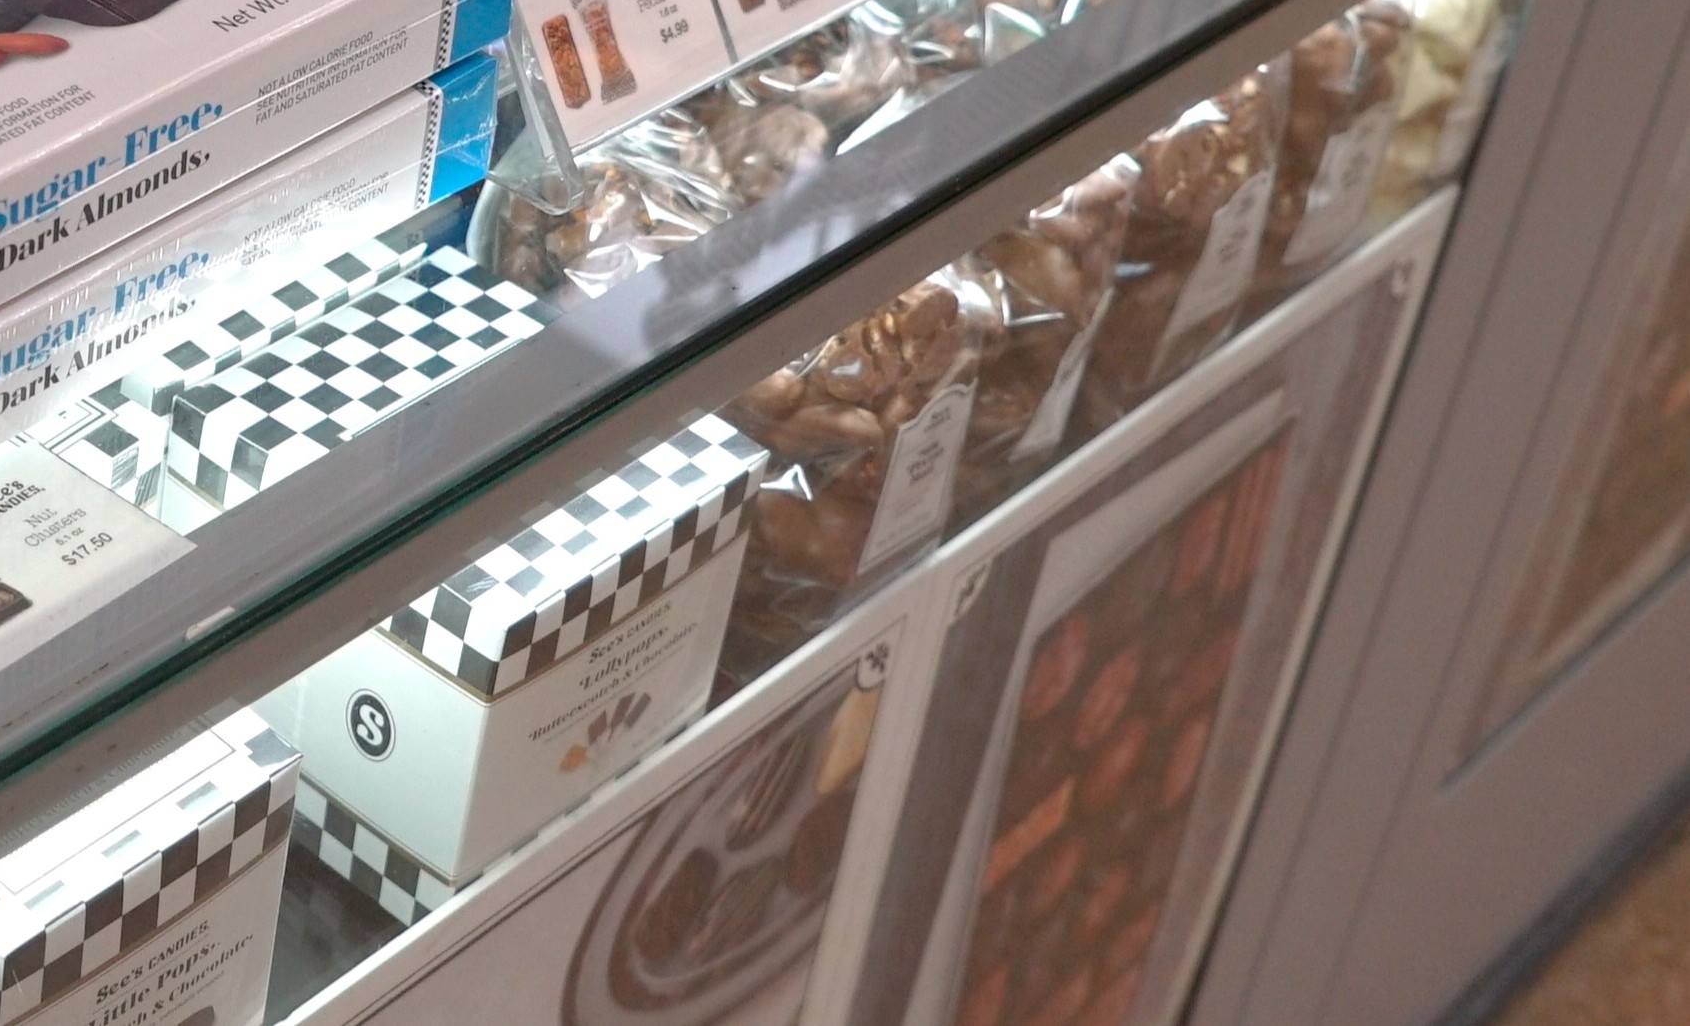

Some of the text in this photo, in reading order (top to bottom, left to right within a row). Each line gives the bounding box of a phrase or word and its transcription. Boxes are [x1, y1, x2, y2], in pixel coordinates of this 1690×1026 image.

[211, 8, 257, 33] Net
[659, 18, 690, 44] $4.99
[254, 37, 410, 125] FAT AND SATURATED FAT CONTENT
[258, 30, 375, 98] NOT LOW CALORIE FOOD
[24, 116, 48, 133] FAT
[43, 89, 97, 121] CONTENT
[56, 83, 84, 102] FOR
[23, 507, 59, 528] Nut
[24, 507, 88, 548] Clusters
[61, 531, 114, 567] $17.50
[95, 962, 144, 1006] See's
